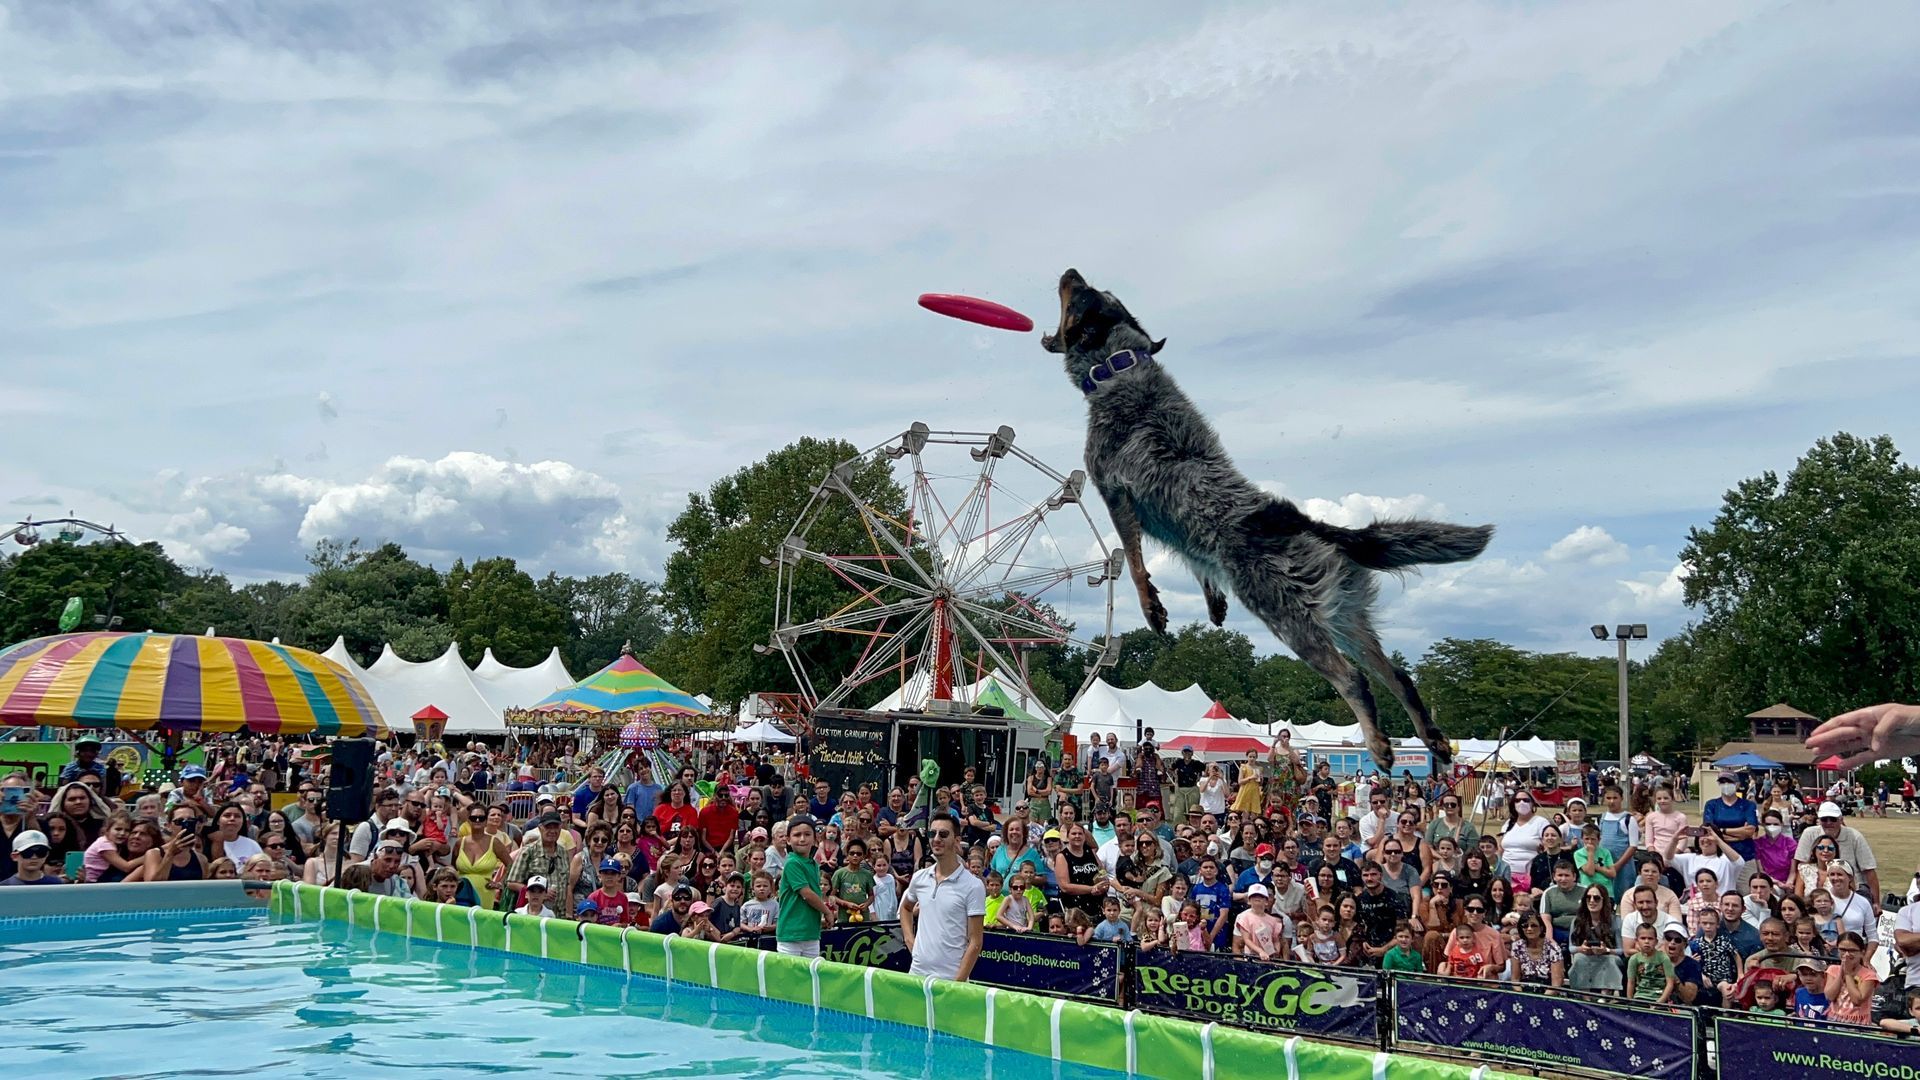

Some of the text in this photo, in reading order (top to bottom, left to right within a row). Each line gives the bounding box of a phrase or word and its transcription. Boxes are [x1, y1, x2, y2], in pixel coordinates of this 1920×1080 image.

[815, 727, 842, 737] CUSTOM
[979, 949, 1080, 970] eadyGoDogShow.com
[1184, 993, 1297, 1029] Dog Show
[1461, 1040, 1581, 1064] www.ReadyGoDogShow.com
